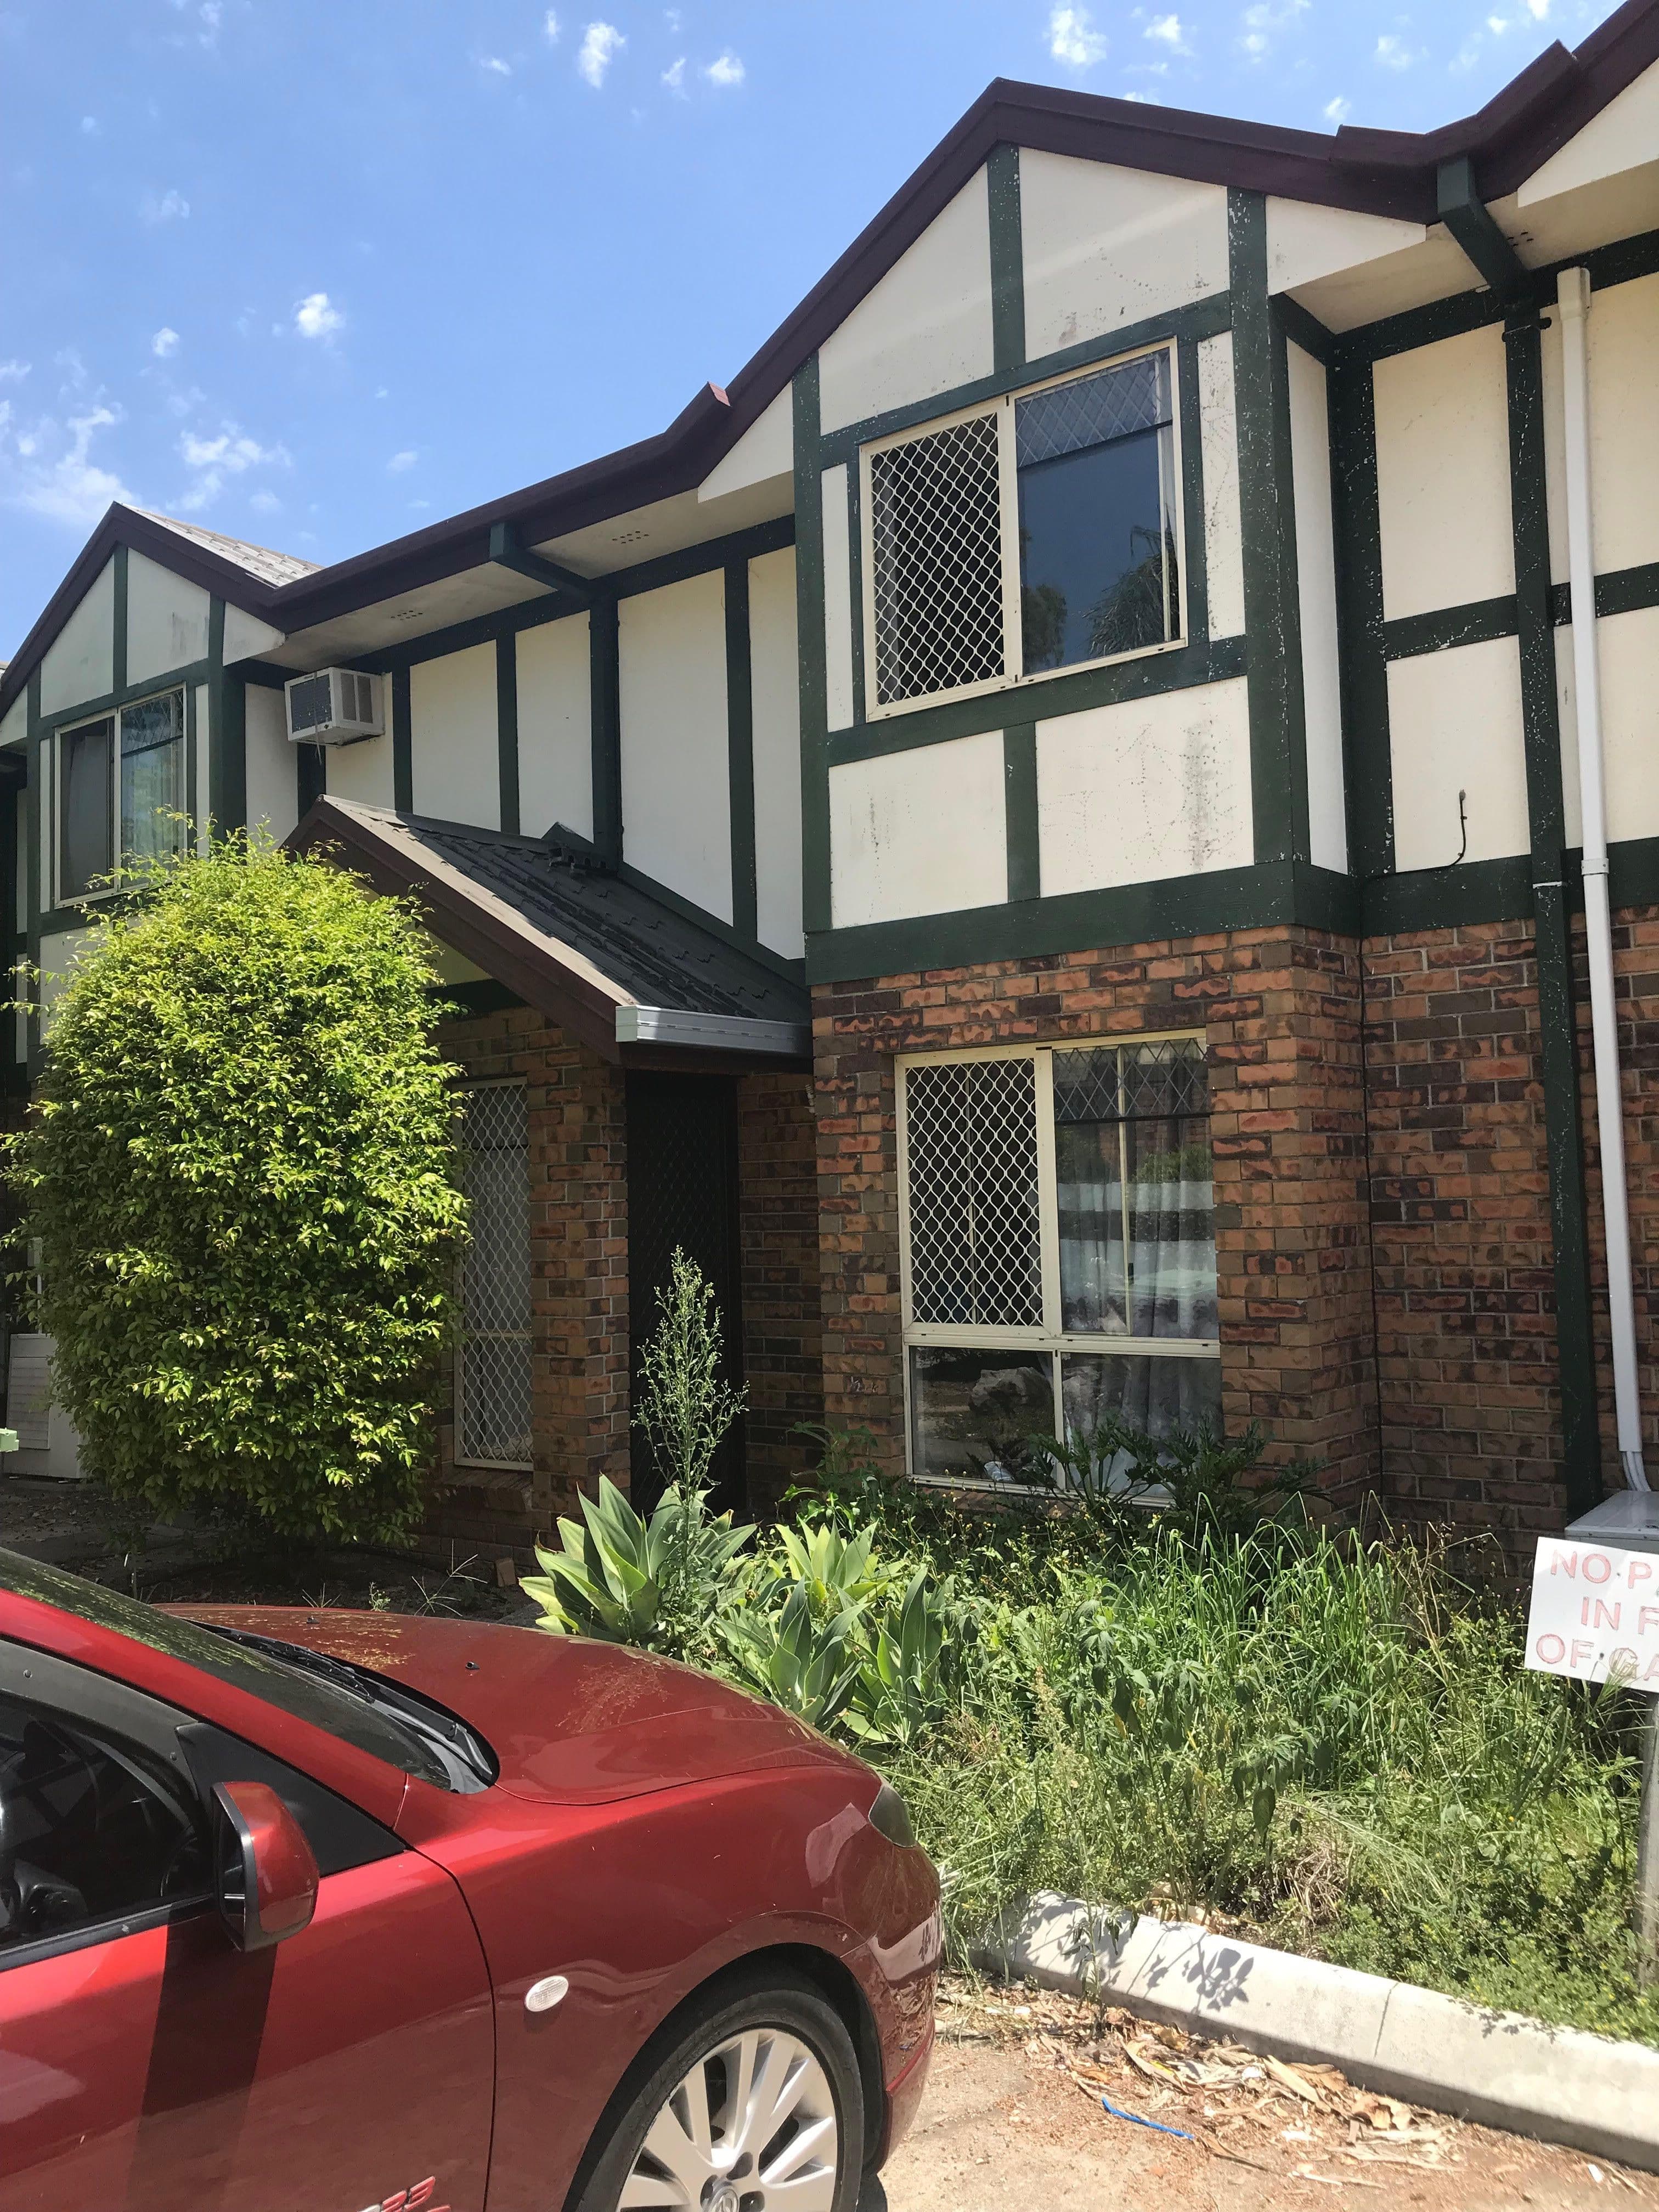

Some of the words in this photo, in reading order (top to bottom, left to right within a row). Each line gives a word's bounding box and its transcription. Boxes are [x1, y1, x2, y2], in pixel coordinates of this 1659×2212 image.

[1550, 1549, 1612, 1584] NO
[1581, 1596, 1621, 1630] IN
[1536, 1633, 1594, 1668] OF
